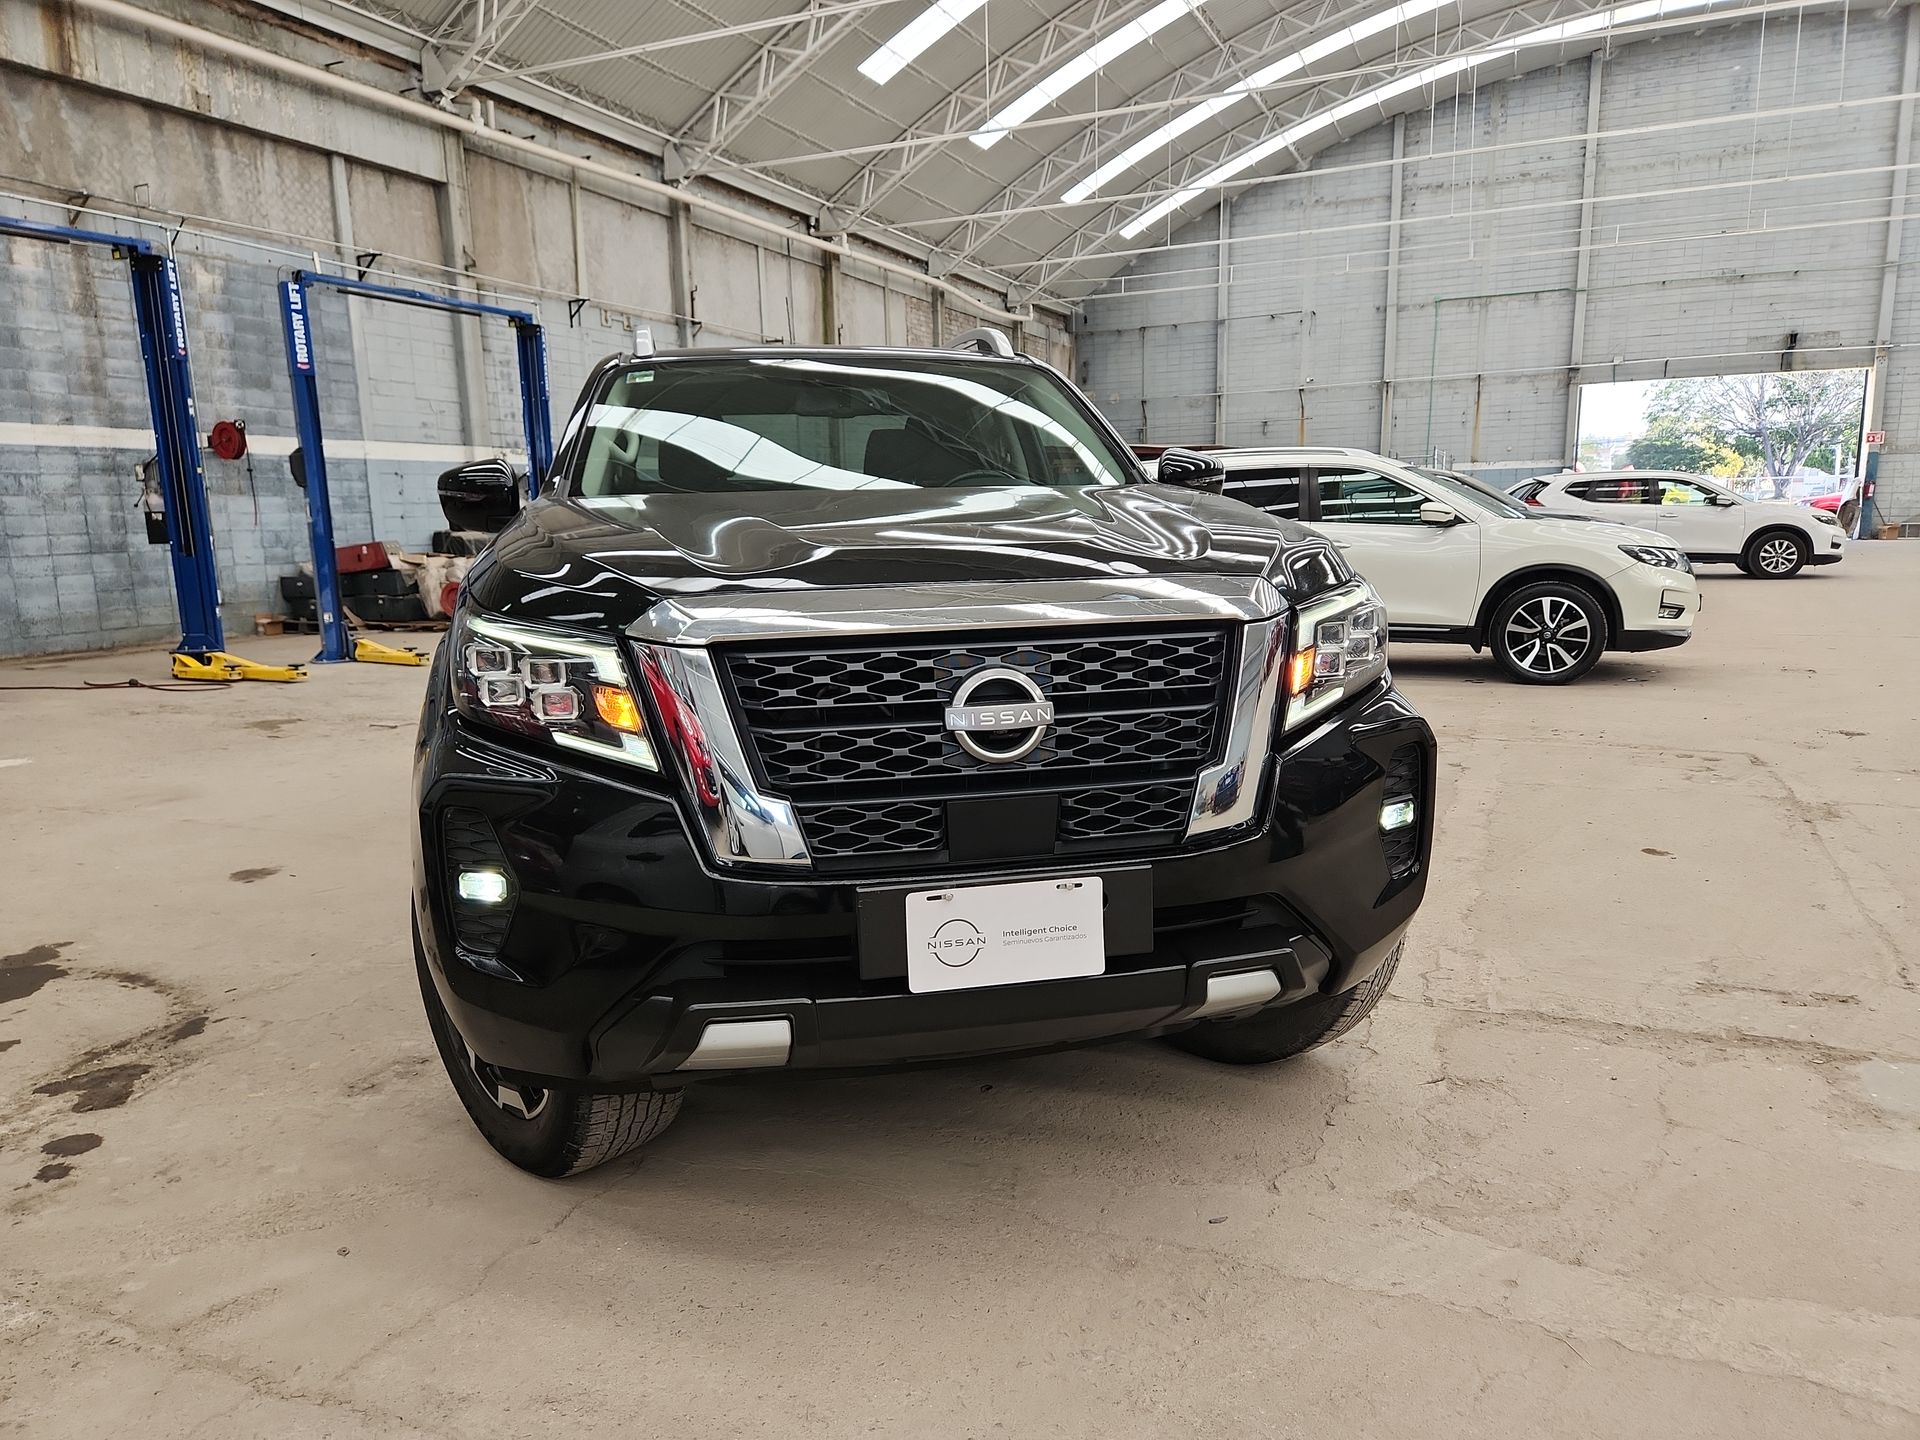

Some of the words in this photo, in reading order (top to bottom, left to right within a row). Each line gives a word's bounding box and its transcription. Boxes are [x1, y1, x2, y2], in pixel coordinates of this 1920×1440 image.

[288, 281, 302, 310] LIFT
[291, 312, 309, 363] ROTARY
[949, 707, 1052, 727] NISSAN
[1002, 927, 1047, 937] Intelligent
[1049, 924, 1078, 933] Choice
[927, 936, 987, 950] NISSAN
[1002, 937, 1043, 946] Seminuevos
[1044, 933, 1087, 943] Garantizados
